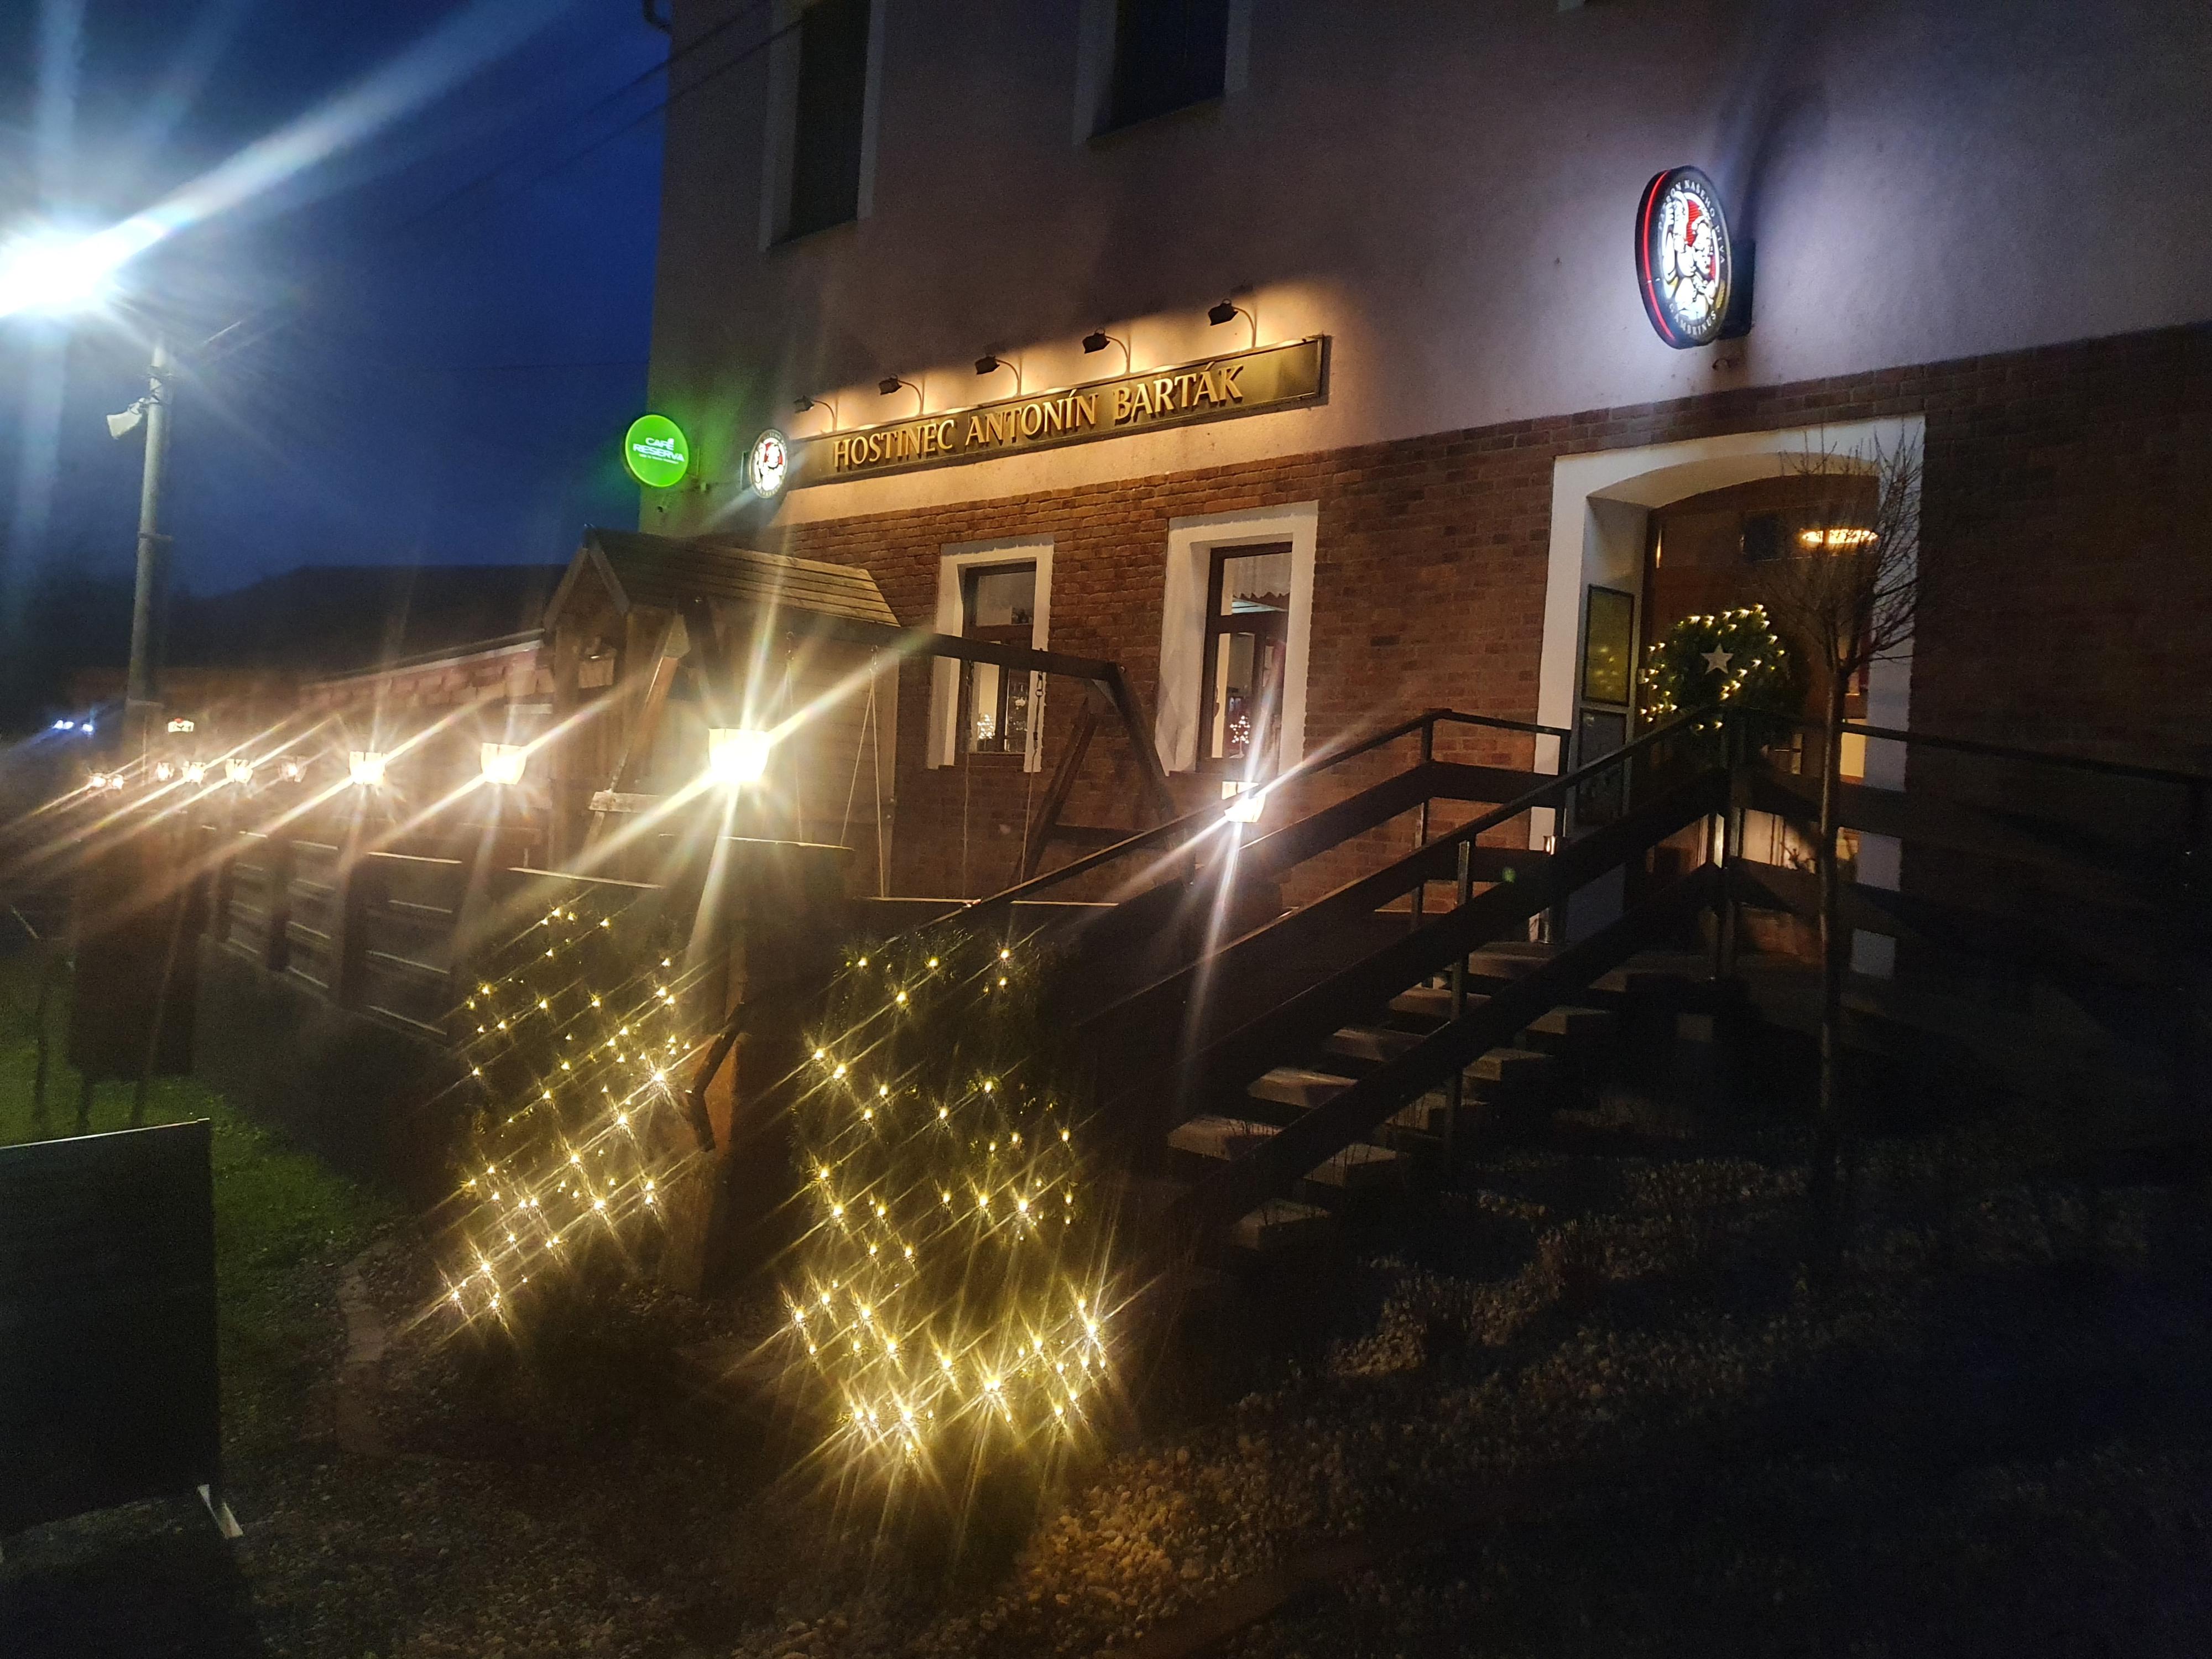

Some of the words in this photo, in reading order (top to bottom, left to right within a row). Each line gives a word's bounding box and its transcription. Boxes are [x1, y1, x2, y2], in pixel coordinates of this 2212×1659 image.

[1669, 303, 1717, 336] GAMBRINUS
[833, 419, 956, 468] HOSTINEC
[966, 389, 1099, 446] ANTONÍN
[1113, 361, 1244, 420] BARTÁK
[633, 443, 685, 462] RESERVA
